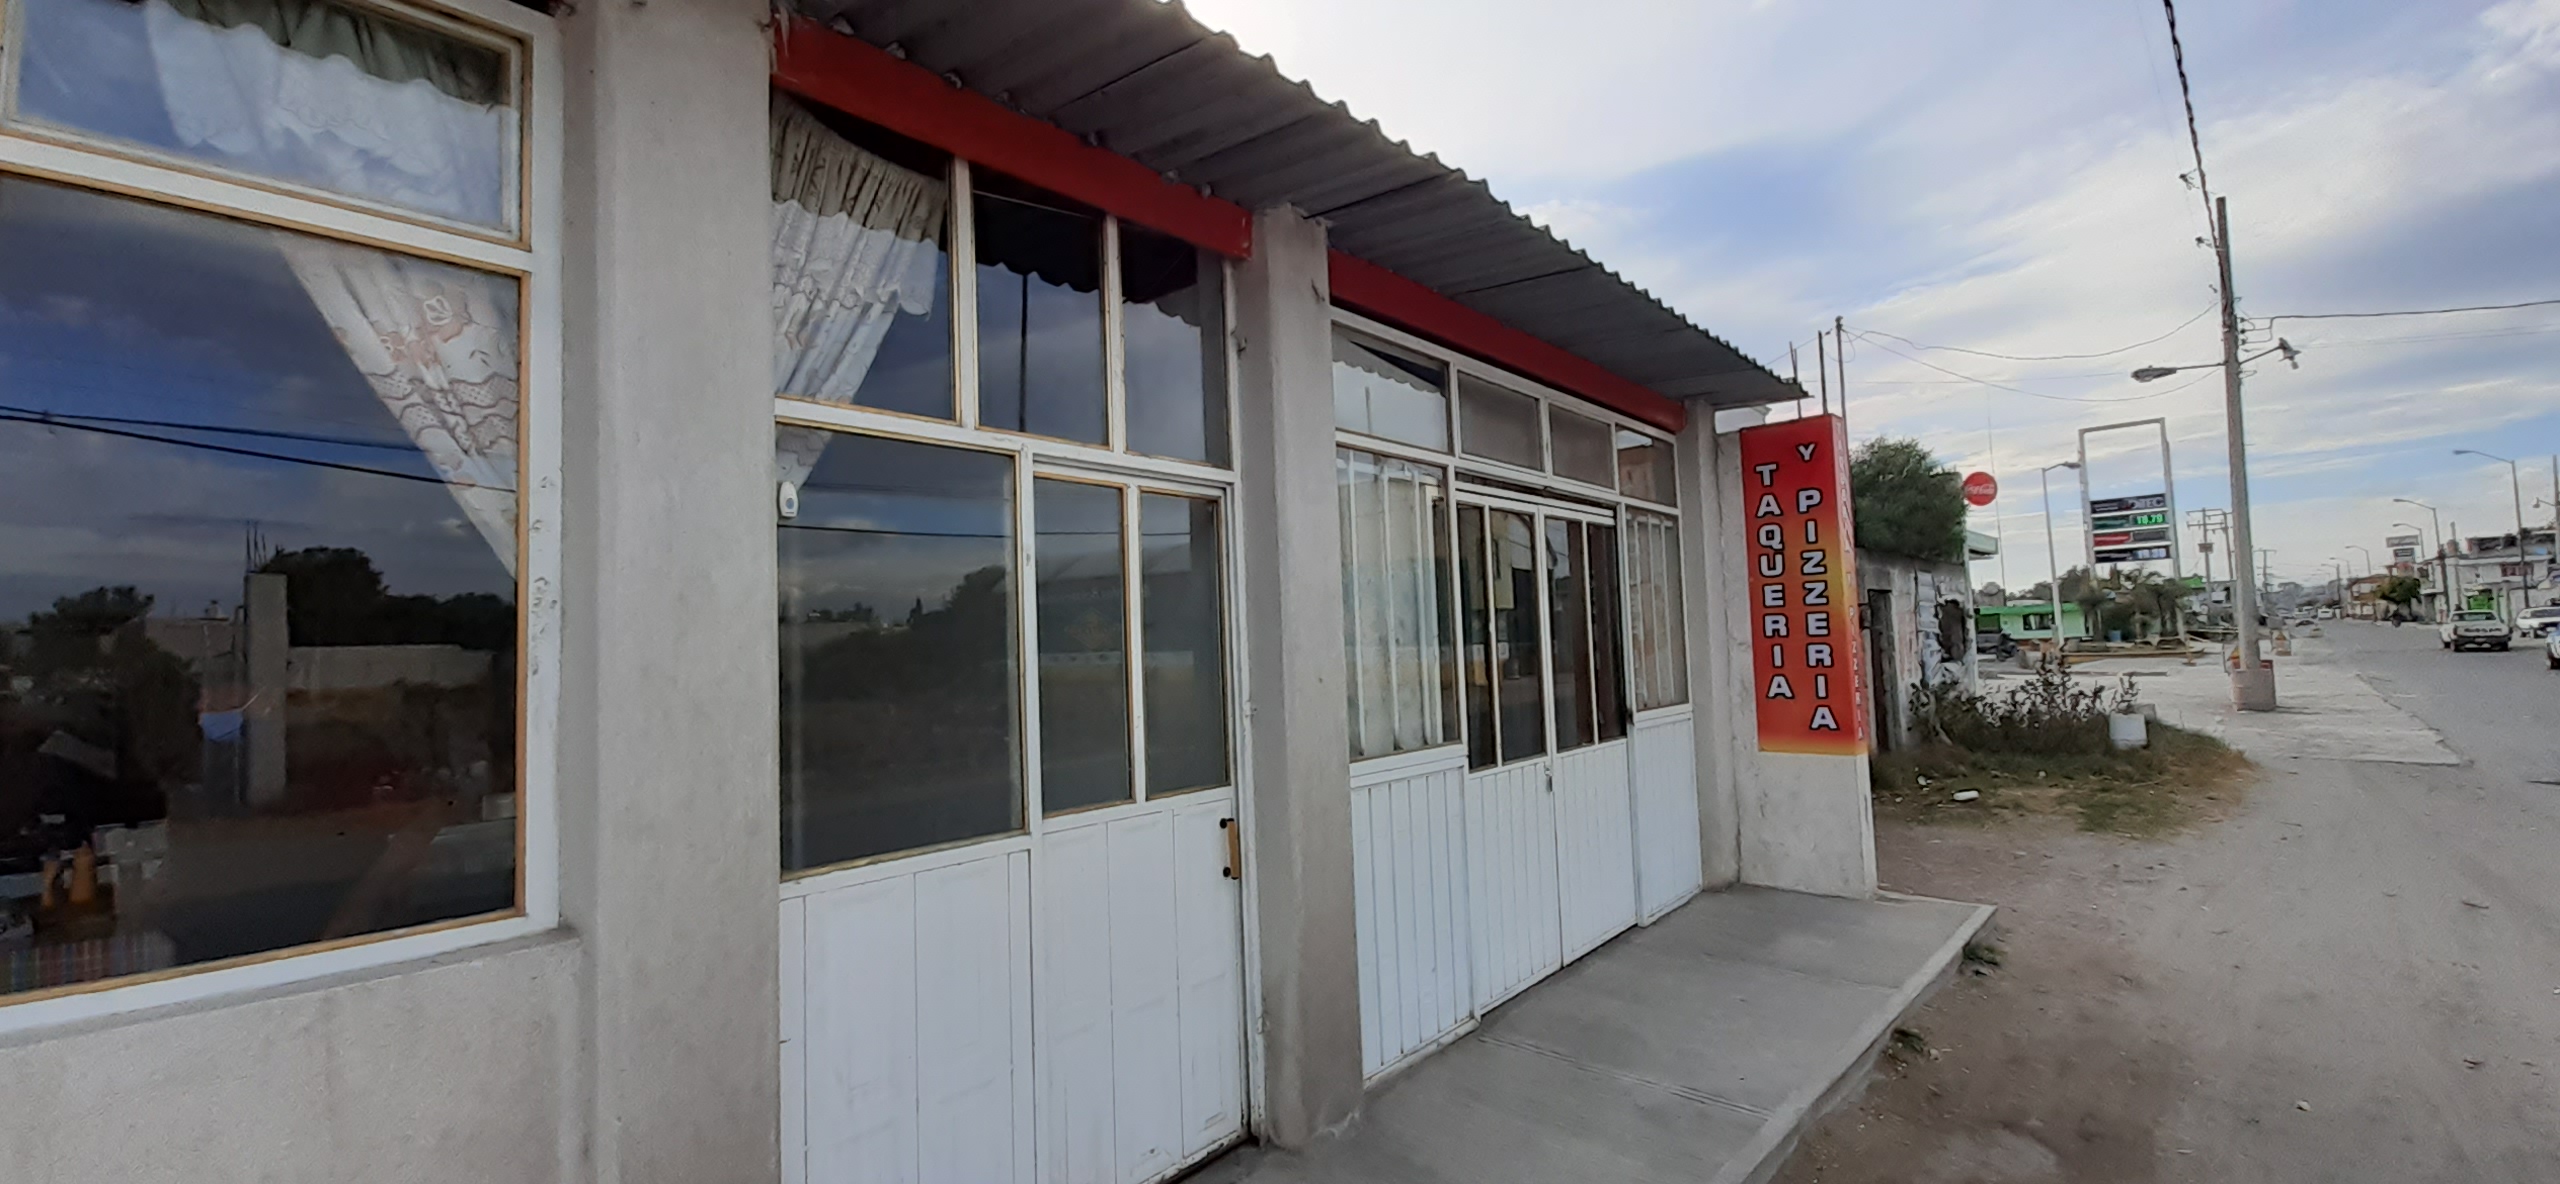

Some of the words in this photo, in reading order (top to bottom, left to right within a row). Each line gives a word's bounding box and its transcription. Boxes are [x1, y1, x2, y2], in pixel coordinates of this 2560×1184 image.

[1797, 443, 1816, 462] Y
[1755, 463, 1795, 699] TAQUERIA
[1797, 488, 1838, 730] PIZZERIA
